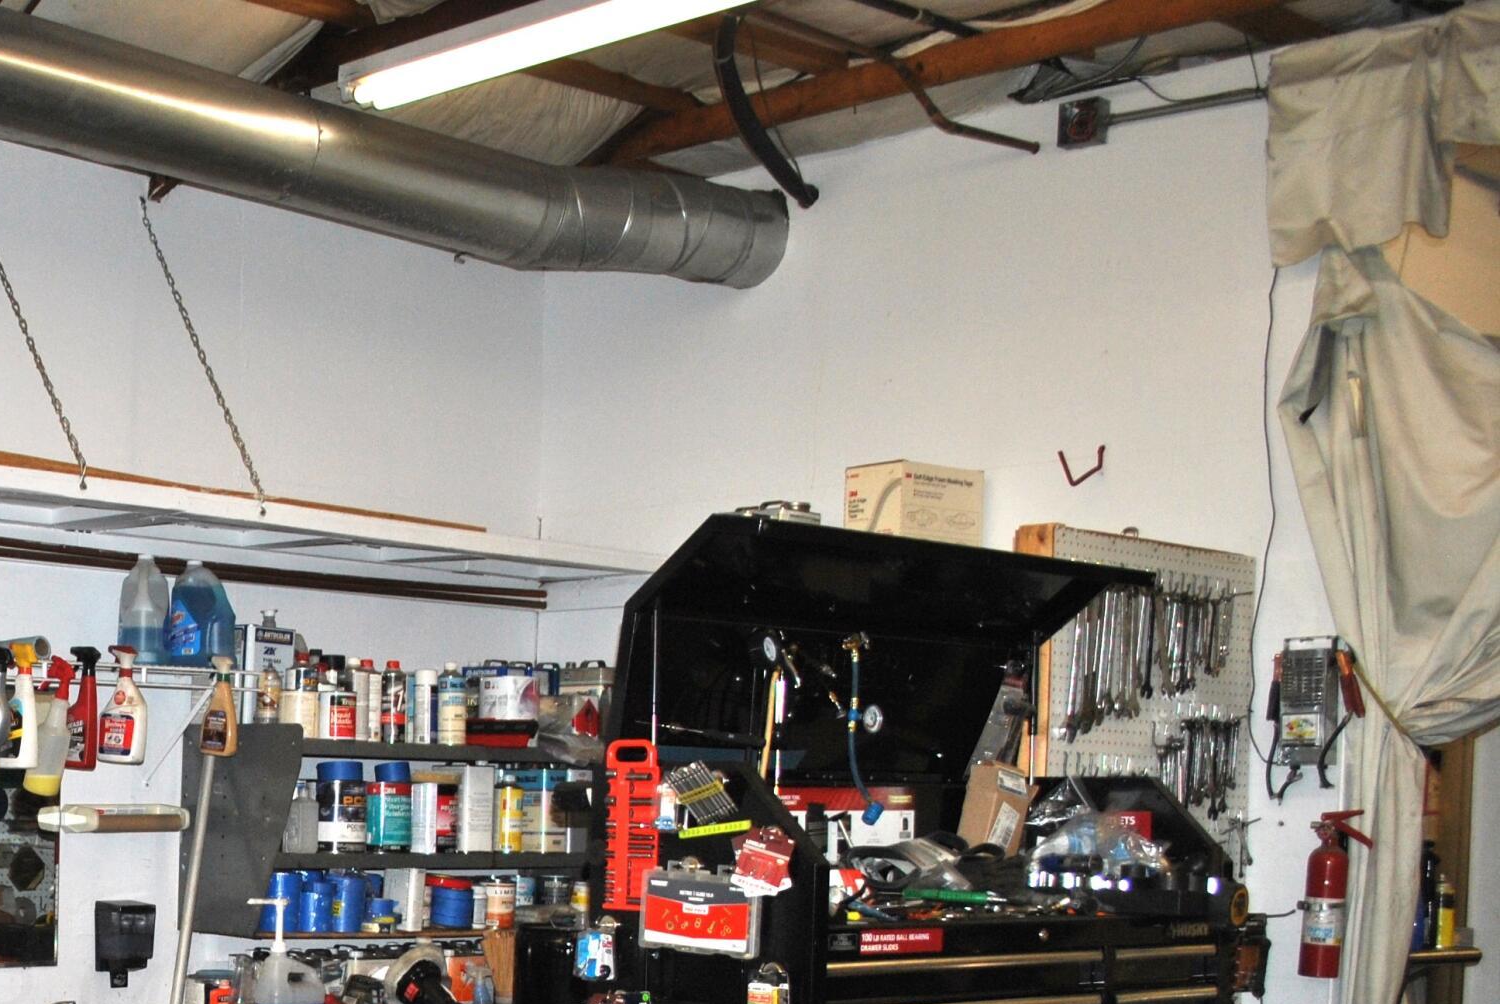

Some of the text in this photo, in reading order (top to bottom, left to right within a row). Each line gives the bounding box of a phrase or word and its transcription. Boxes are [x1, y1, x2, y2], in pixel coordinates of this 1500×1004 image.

[1174, 922, 1209, 937] HUSKY
[861, 933, 873, 942] 100
[908, 933, 930, 941] BEARING
[860, 943, 899, 952] DRAWER SLIDES
